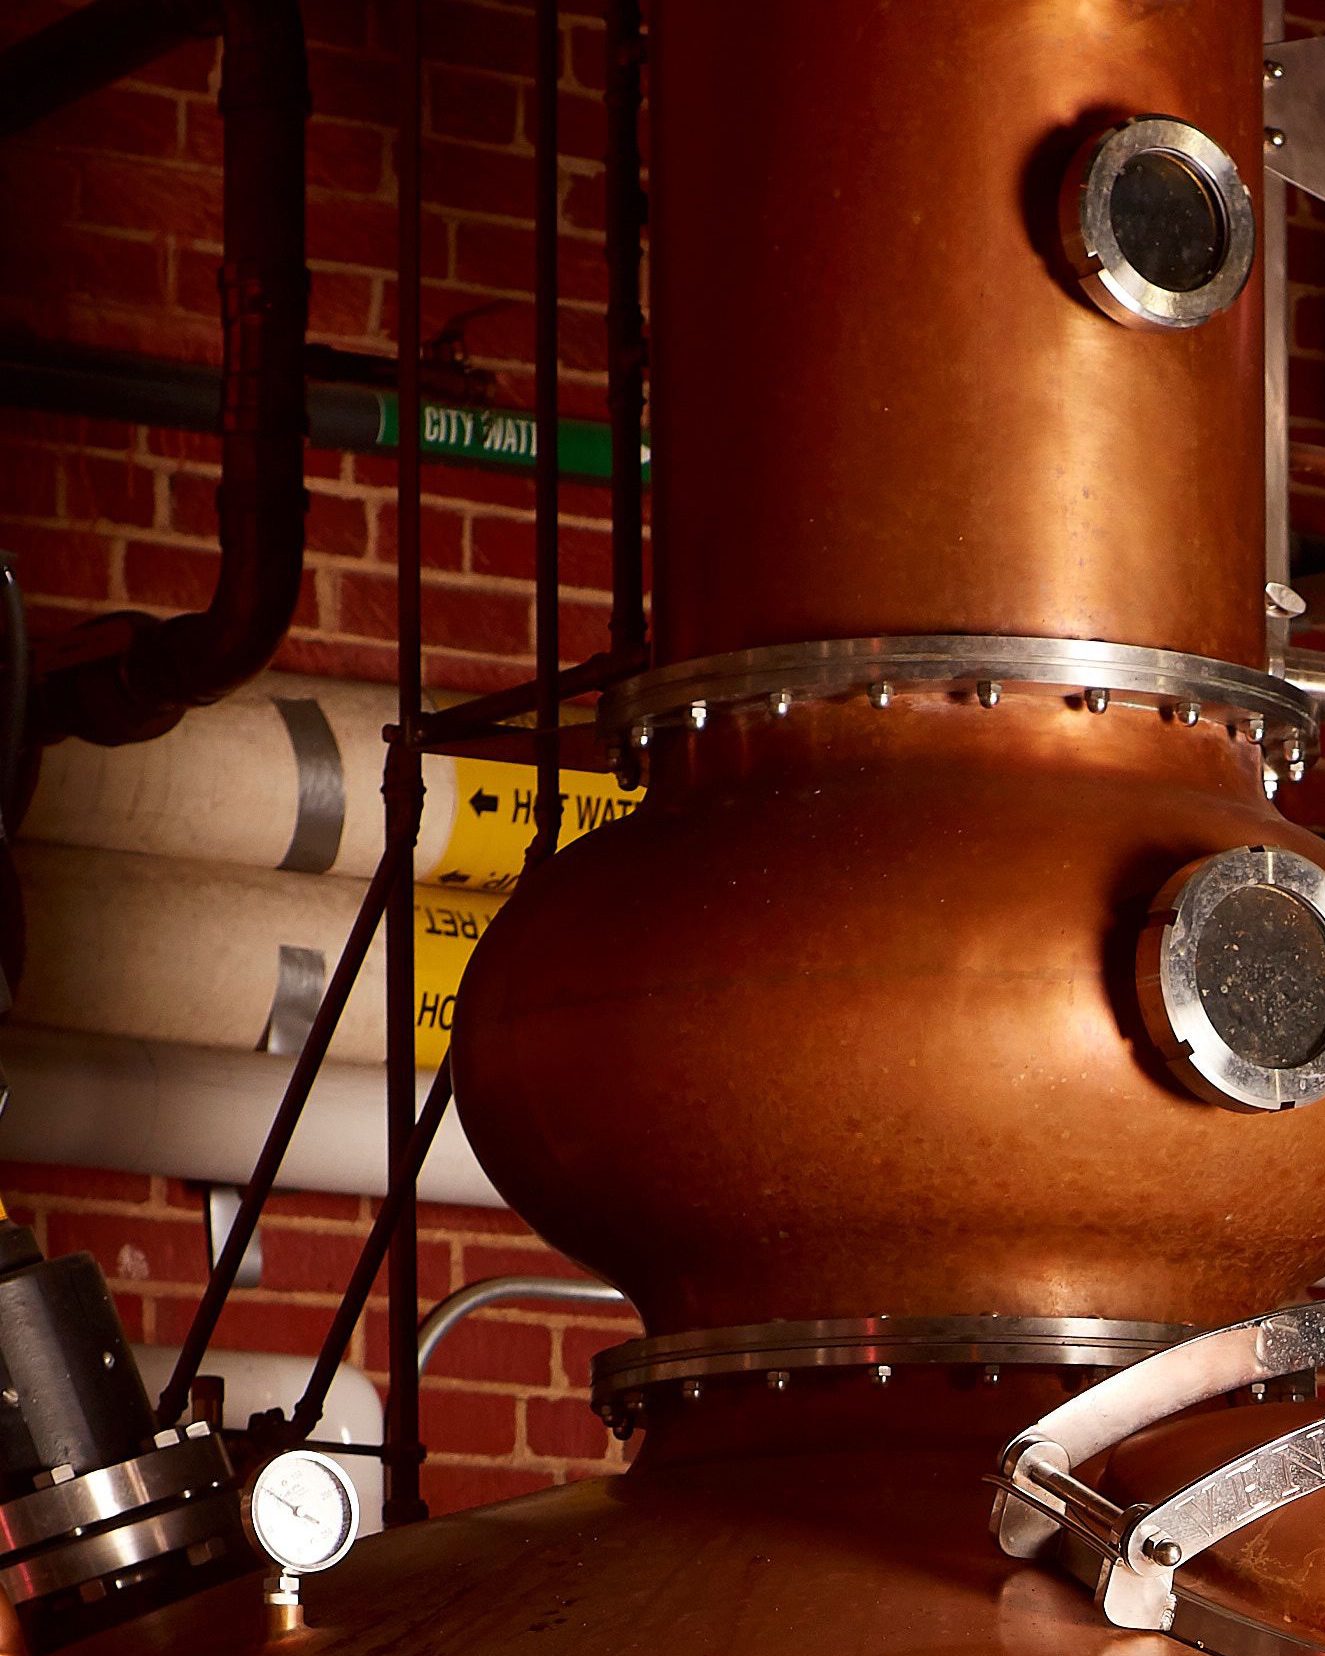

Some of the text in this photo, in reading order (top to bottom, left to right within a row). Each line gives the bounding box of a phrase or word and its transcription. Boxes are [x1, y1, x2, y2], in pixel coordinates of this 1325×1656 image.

[424, 405, 537, 458] CITY WAT
[576, 795, 642, 830] WAT
[417, 991, 457, 1031] HO
